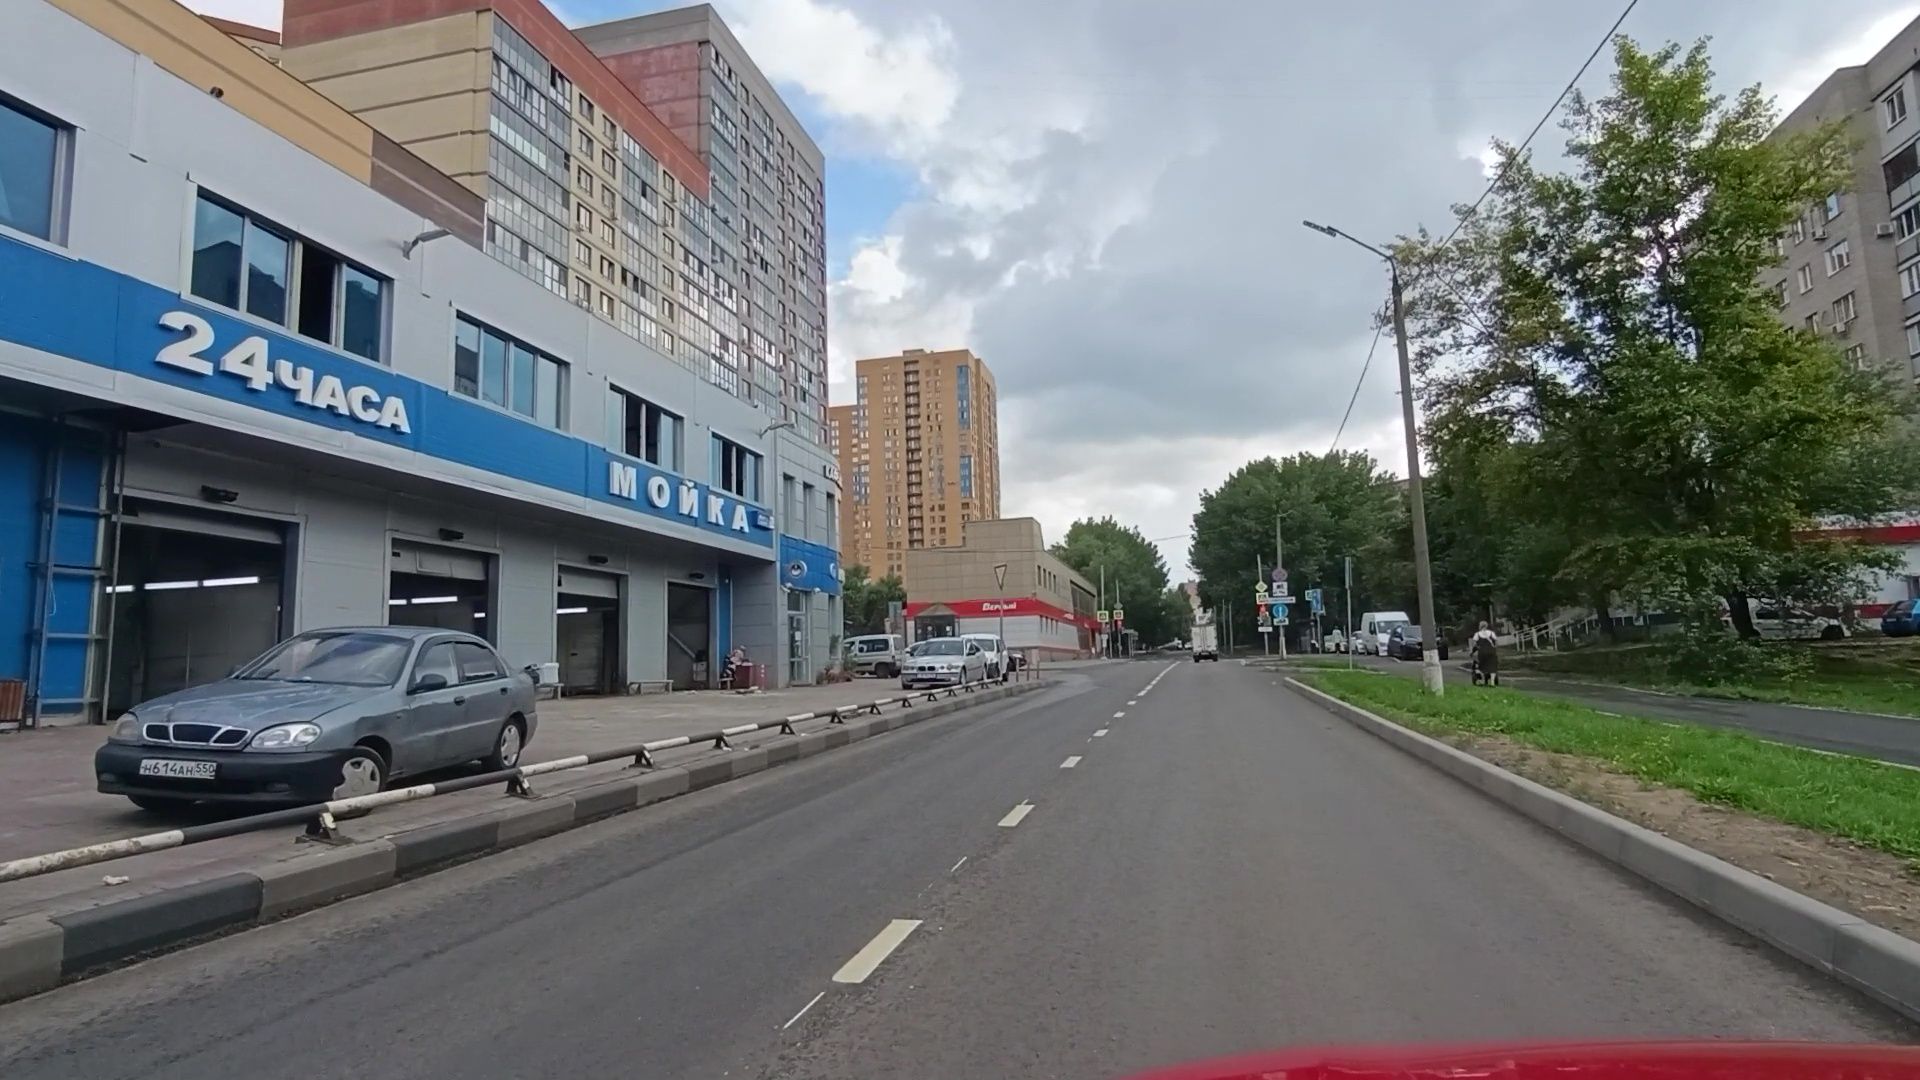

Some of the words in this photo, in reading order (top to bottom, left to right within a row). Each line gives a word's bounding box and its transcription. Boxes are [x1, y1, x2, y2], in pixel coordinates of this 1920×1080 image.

[155, 311, 274, 392] 24
[274, 359, 412, 434] ЧАСА
[609, 461, 750, 533] МОЙКА
